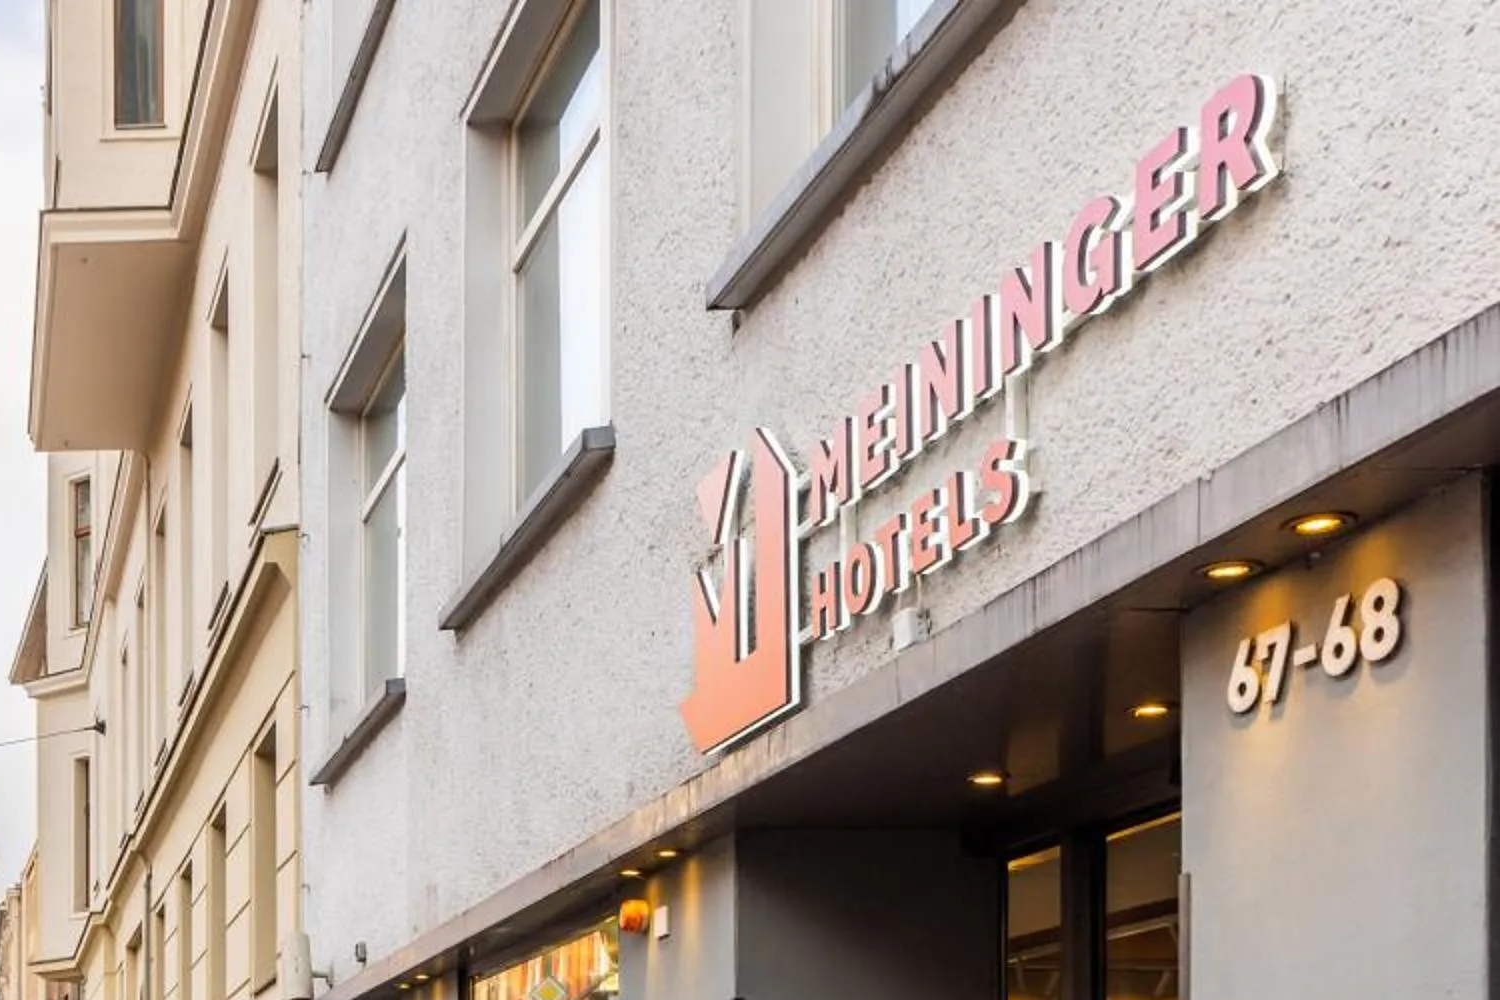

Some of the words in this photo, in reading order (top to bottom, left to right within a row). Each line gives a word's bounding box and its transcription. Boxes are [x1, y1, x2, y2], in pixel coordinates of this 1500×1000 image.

[810, 73, 1277, 527] MEININGER
[811, 437, 1030, 640] HOTELS
[1227, 577, 1401, 714] 67-68
